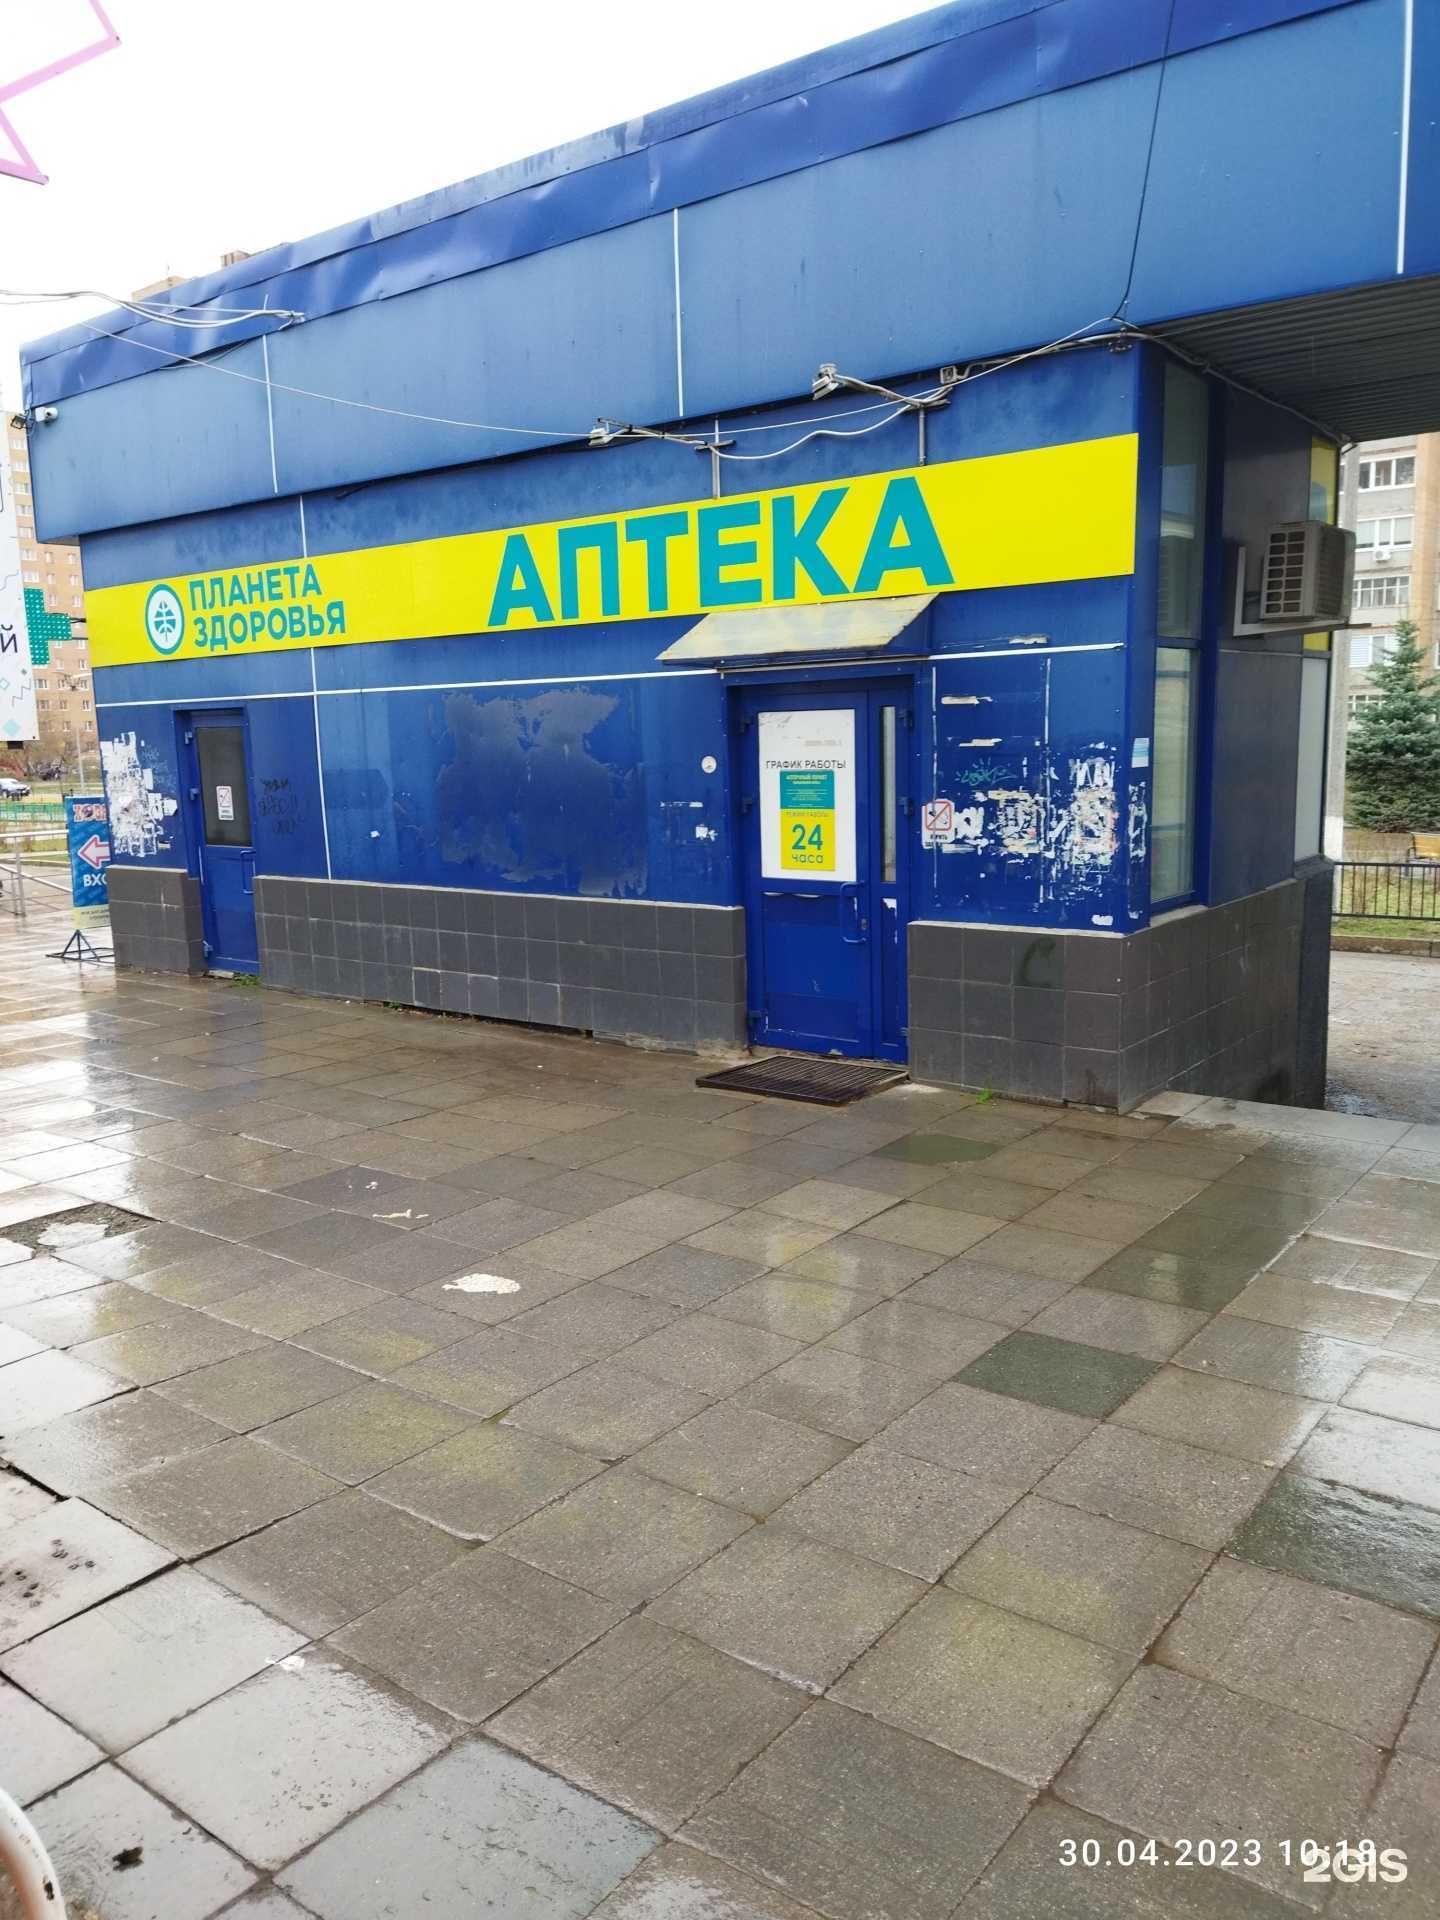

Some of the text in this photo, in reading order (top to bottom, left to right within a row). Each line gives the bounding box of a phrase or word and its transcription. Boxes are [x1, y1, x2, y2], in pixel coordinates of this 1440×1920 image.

[487, 476, 955, 627] АПТЕКА
[188, 563, 322, 611] ПЛАНЕТА
[193, 600, 346, 651] ЗДОРОВЬЯ
[765, 759, 846, 769] ГРАФИК РАБОТЫ
[791, 823, 824, 851] 24
[791, 853, 824, 864] часа
